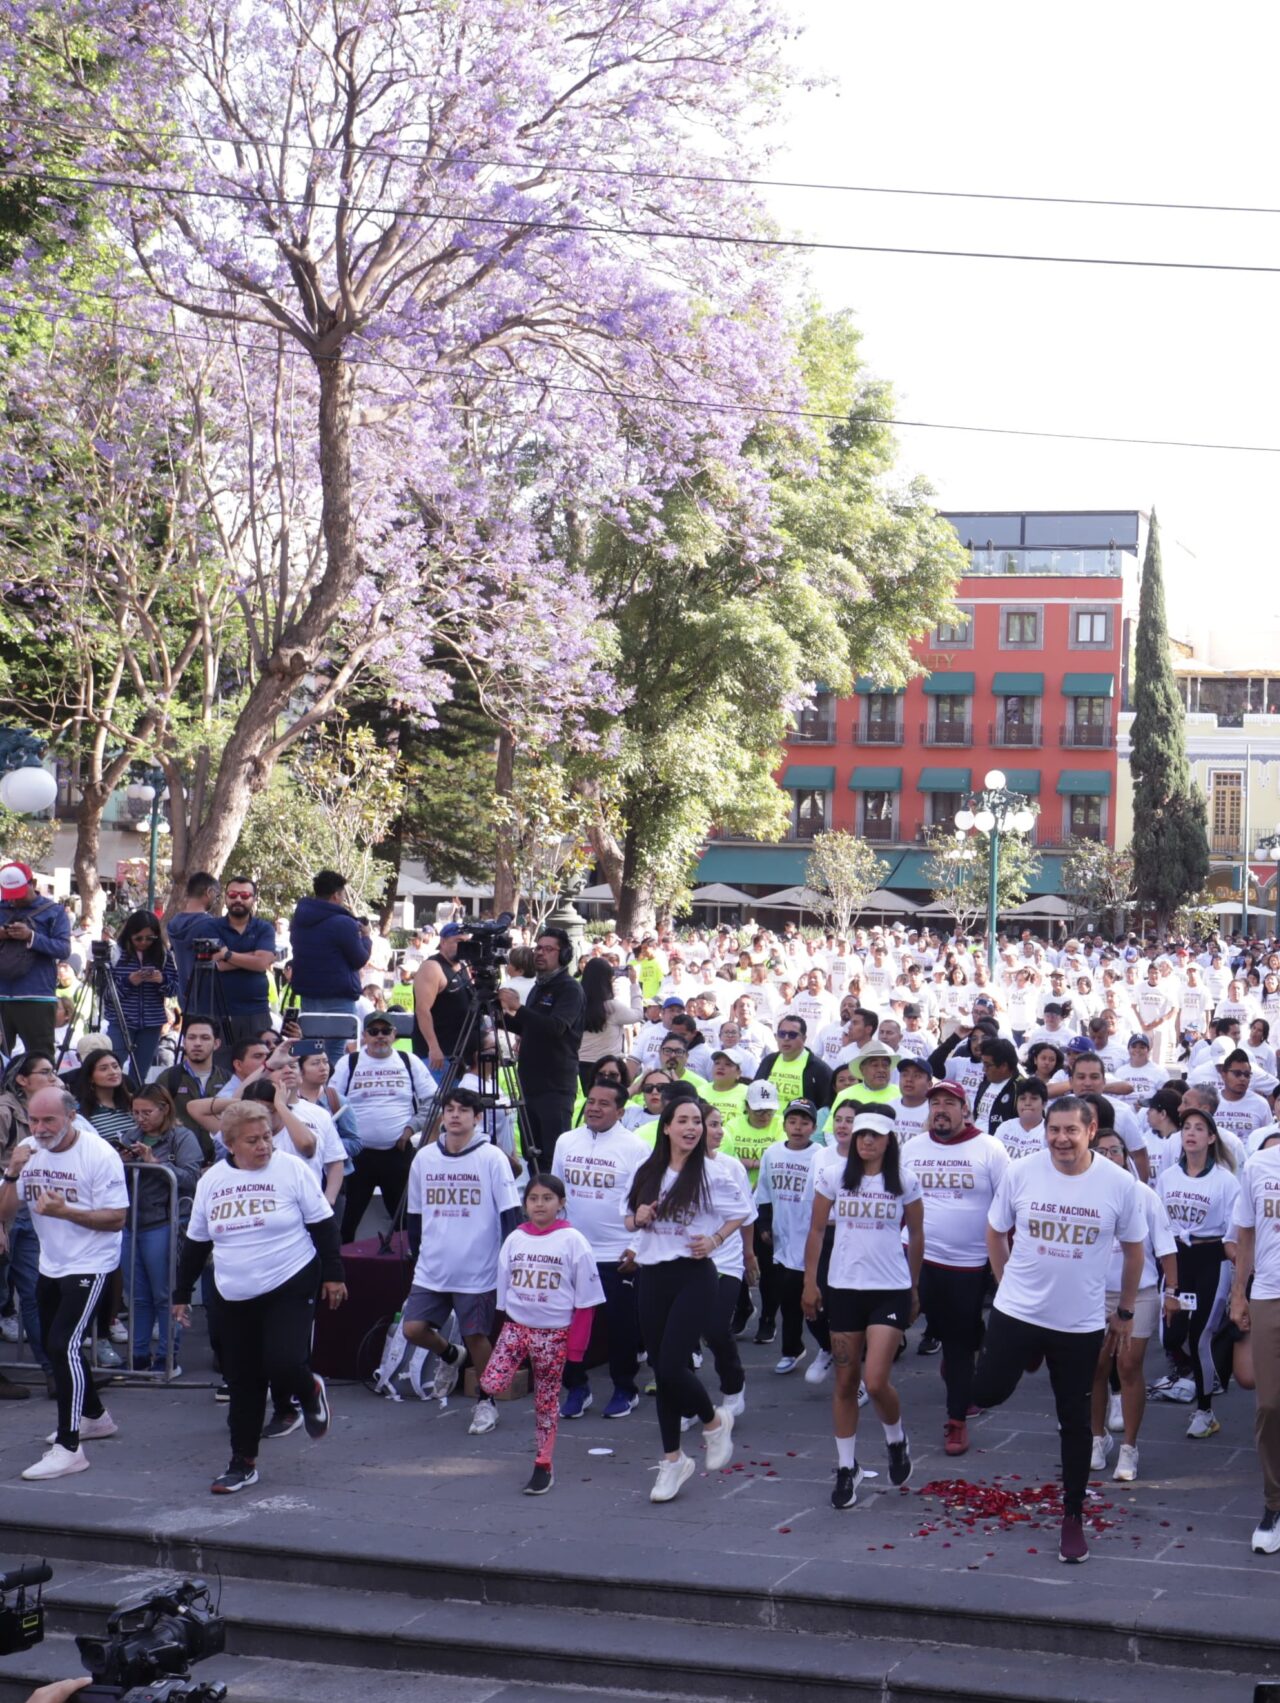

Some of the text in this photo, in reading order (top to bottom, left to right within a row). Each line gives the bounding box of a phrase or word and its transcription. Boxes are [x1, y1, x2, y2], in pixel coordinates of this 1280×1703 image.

[760, 1086, 771, 1099] LA
[565, 1155, 617, 1168] CLASE NACIONAL
[914, 1159, 973, 1167] CLASE NACIONAL
[22, 1169, 78, 1182] CLASE NACIONAL
[426, 1174, 481, 1182] CLASE NACIONAL
[564, 1169, 616, 1189] BOXEO
[917, 1173, 975, 1190] OXEO
[24, 1183, 79, 1203] BOO
[235, 1183, 276, 1193] NACIONAL
[1166, 1190, 1182, 1199] CLASE
[426, 1188, 481, 1205] BOXEO
[838, 1201, 897, 1219] BOXEO
[1030, 1201, 1101, 1218] CLASE NACIONAL
[1166, 1204, 1208, 1224] BOXEO
[1028, 1219, 1101, 1246] BOXEO
[510, 1253, 563, 1265] LASE NACIONAL
